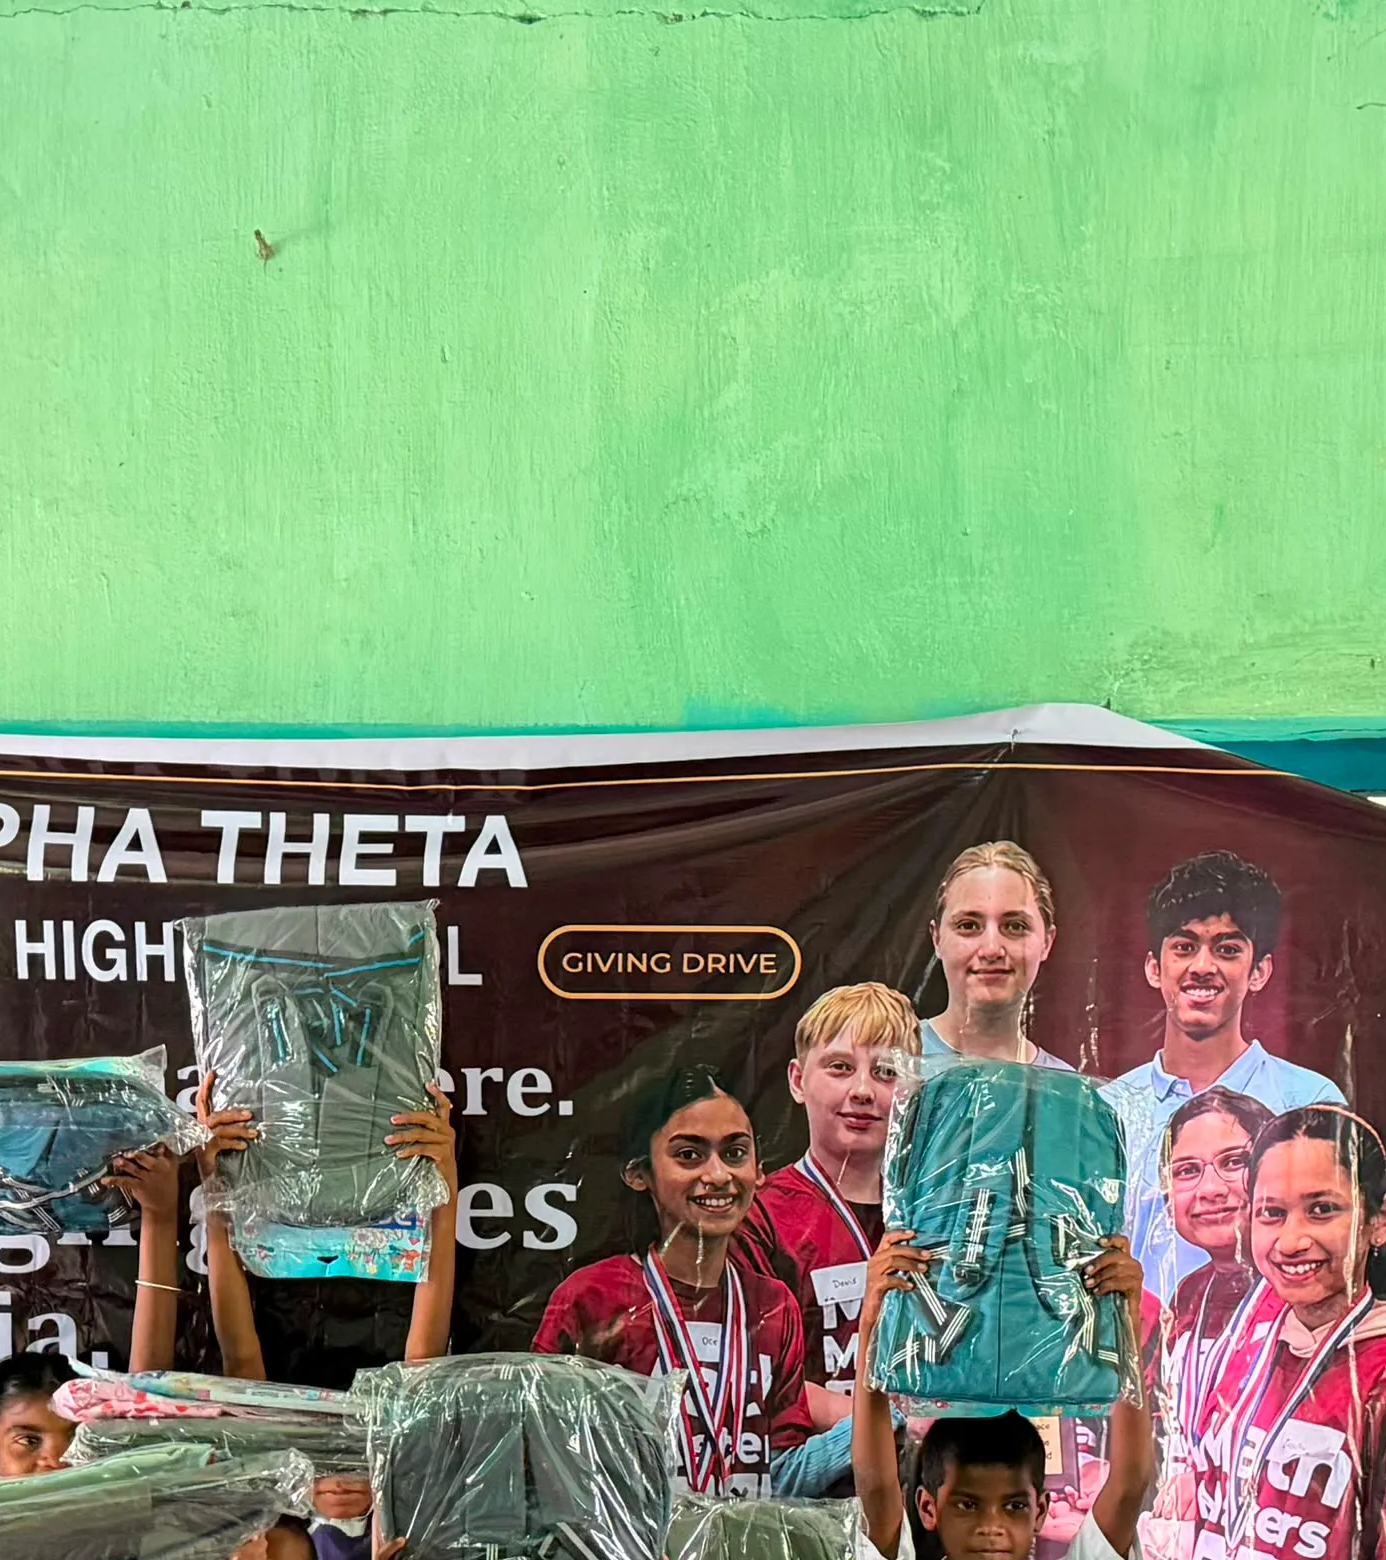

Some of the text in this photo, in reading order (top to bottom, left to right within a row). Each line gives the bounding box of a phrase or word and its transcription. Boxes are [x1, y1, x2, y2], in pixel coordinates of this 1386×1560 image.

[201, 810, 528, 889] THETA
[16, 917, 176, 982] HIGH
[562, 952, 777, 973] GIVING DRIVE
